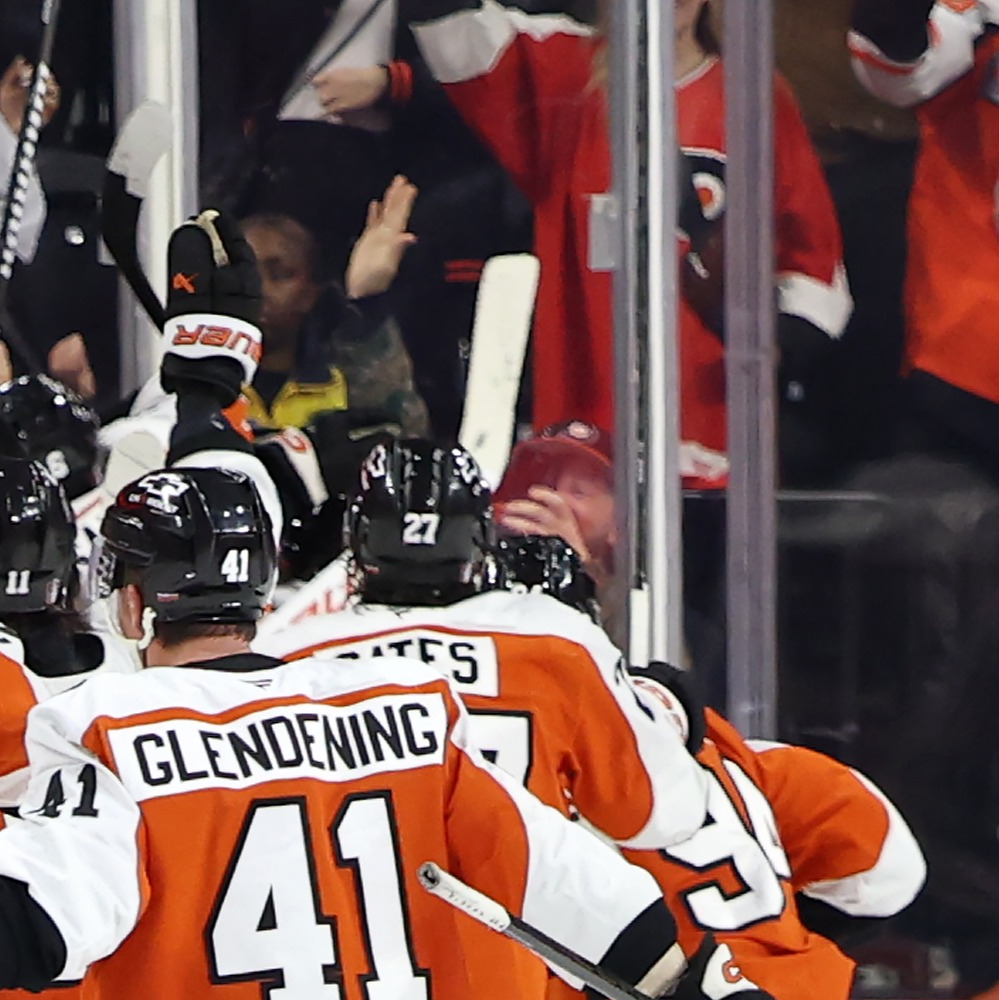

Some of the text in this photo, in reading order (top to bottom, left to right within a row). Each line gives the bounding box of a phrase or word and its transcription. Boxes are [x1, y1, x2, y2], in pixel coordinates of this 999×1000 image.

[403, 513, 440, 545] 27
[5, 570, 31, 595] 11
[221, 549, 249, 582] 41
[336, 638, 479, 684] TES
[132, 702, 439, 787] GLENDENING
[25, 763, 99, 819] 41
